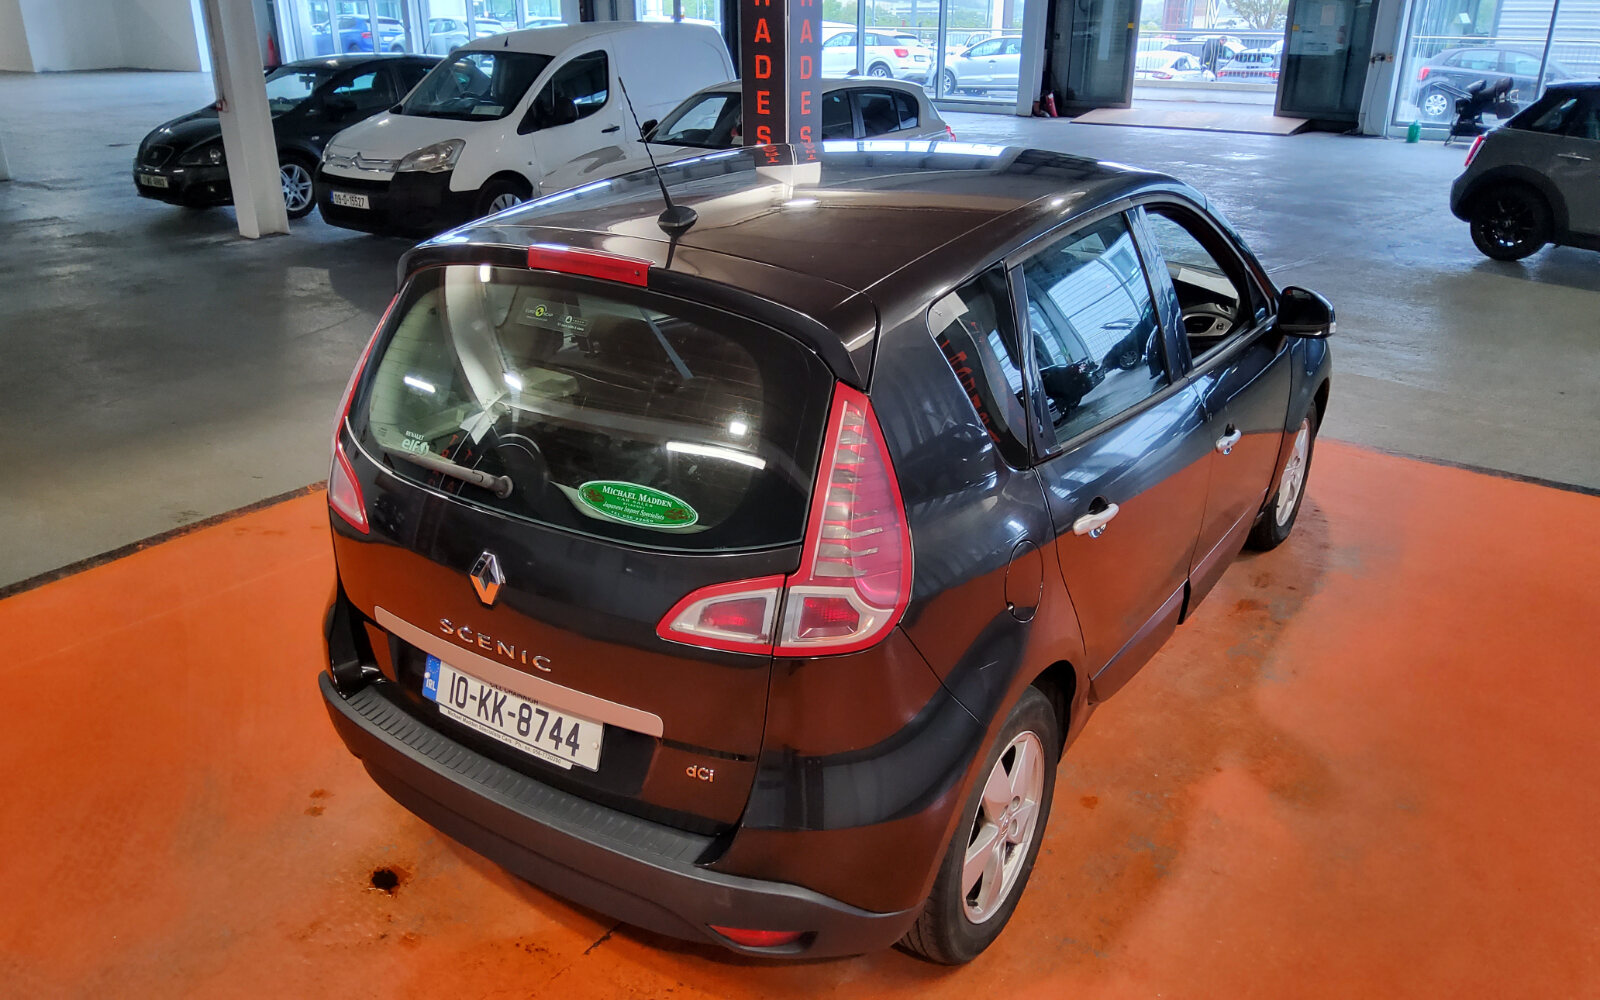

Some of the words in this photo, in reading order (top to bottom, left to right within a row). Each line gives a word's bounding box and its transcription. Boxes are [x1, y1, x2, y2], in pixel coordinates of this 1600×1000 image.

[602, 485, 637, 500] MICHAEL
[638, 493, 673, 508] MADDEN
[602, 501, 623, 511] Japanese
[623, 505, 640, 515] Import
[640, 509, 665, 521] Specialists
[439, 618, 552, 673] SCENIC
[425, 678, 437, 692] IRL
[447, 709, 463, 720] Michael
[463, 716, 479, 727] Madden
[448, 672, 580, 757] 10-KK-8744
[685, 764, 714, 783] dCi
